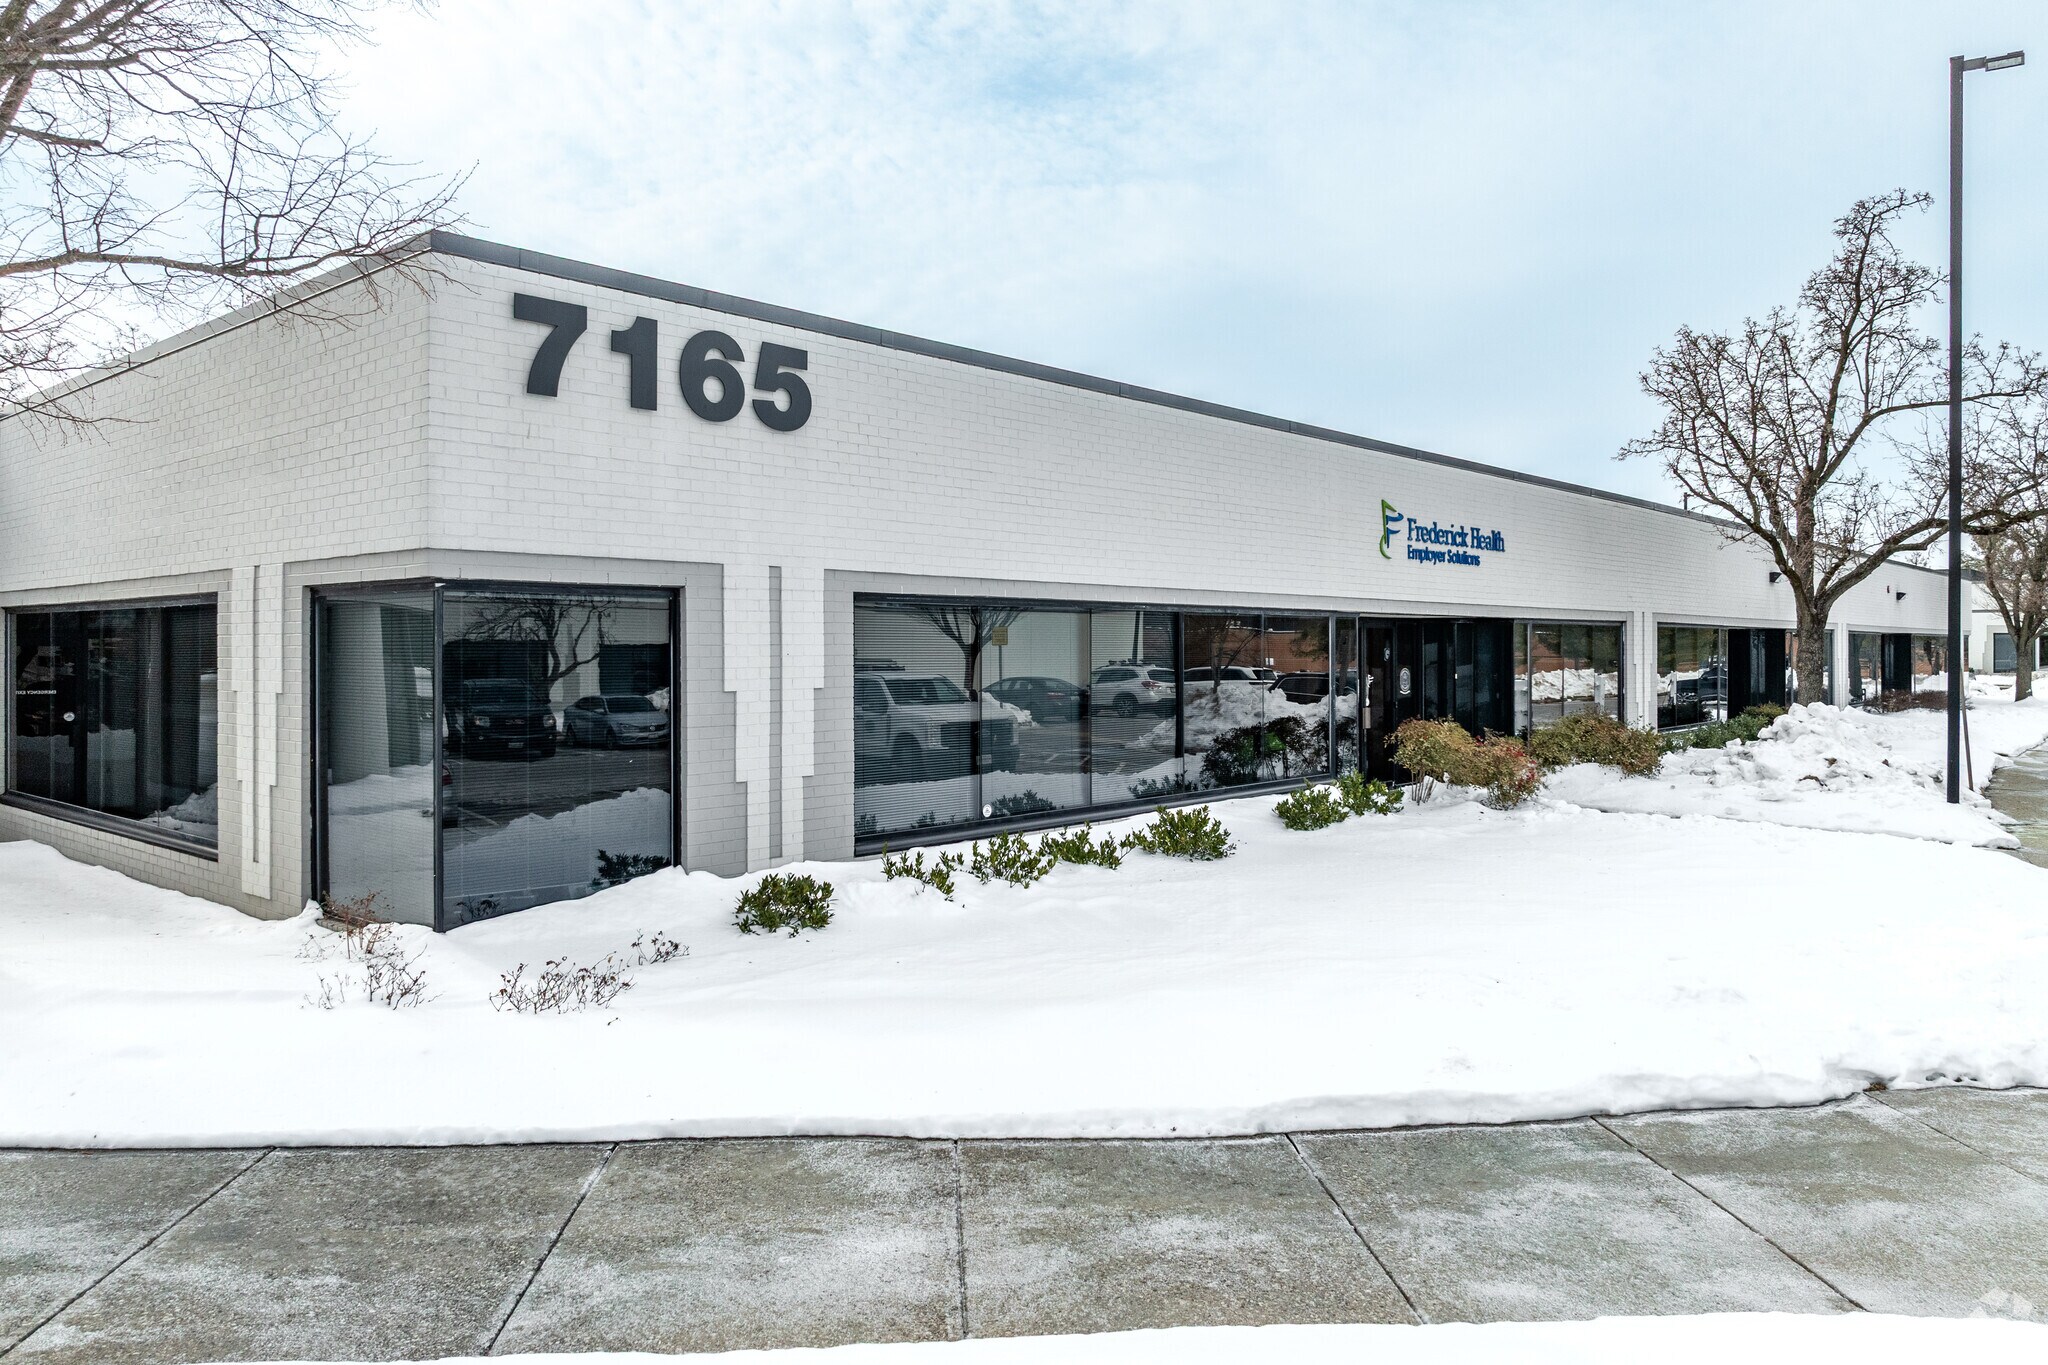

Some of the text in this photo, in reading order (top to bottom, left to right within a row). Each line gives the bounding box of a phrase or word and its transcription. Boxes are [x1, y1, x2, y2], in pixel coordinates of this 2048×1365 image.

[514, 293, 812, 431] 7165
[1407, 517, 1505, 552] Frederick Health
[1407, 545, 1481, 566] Employer Solutions
